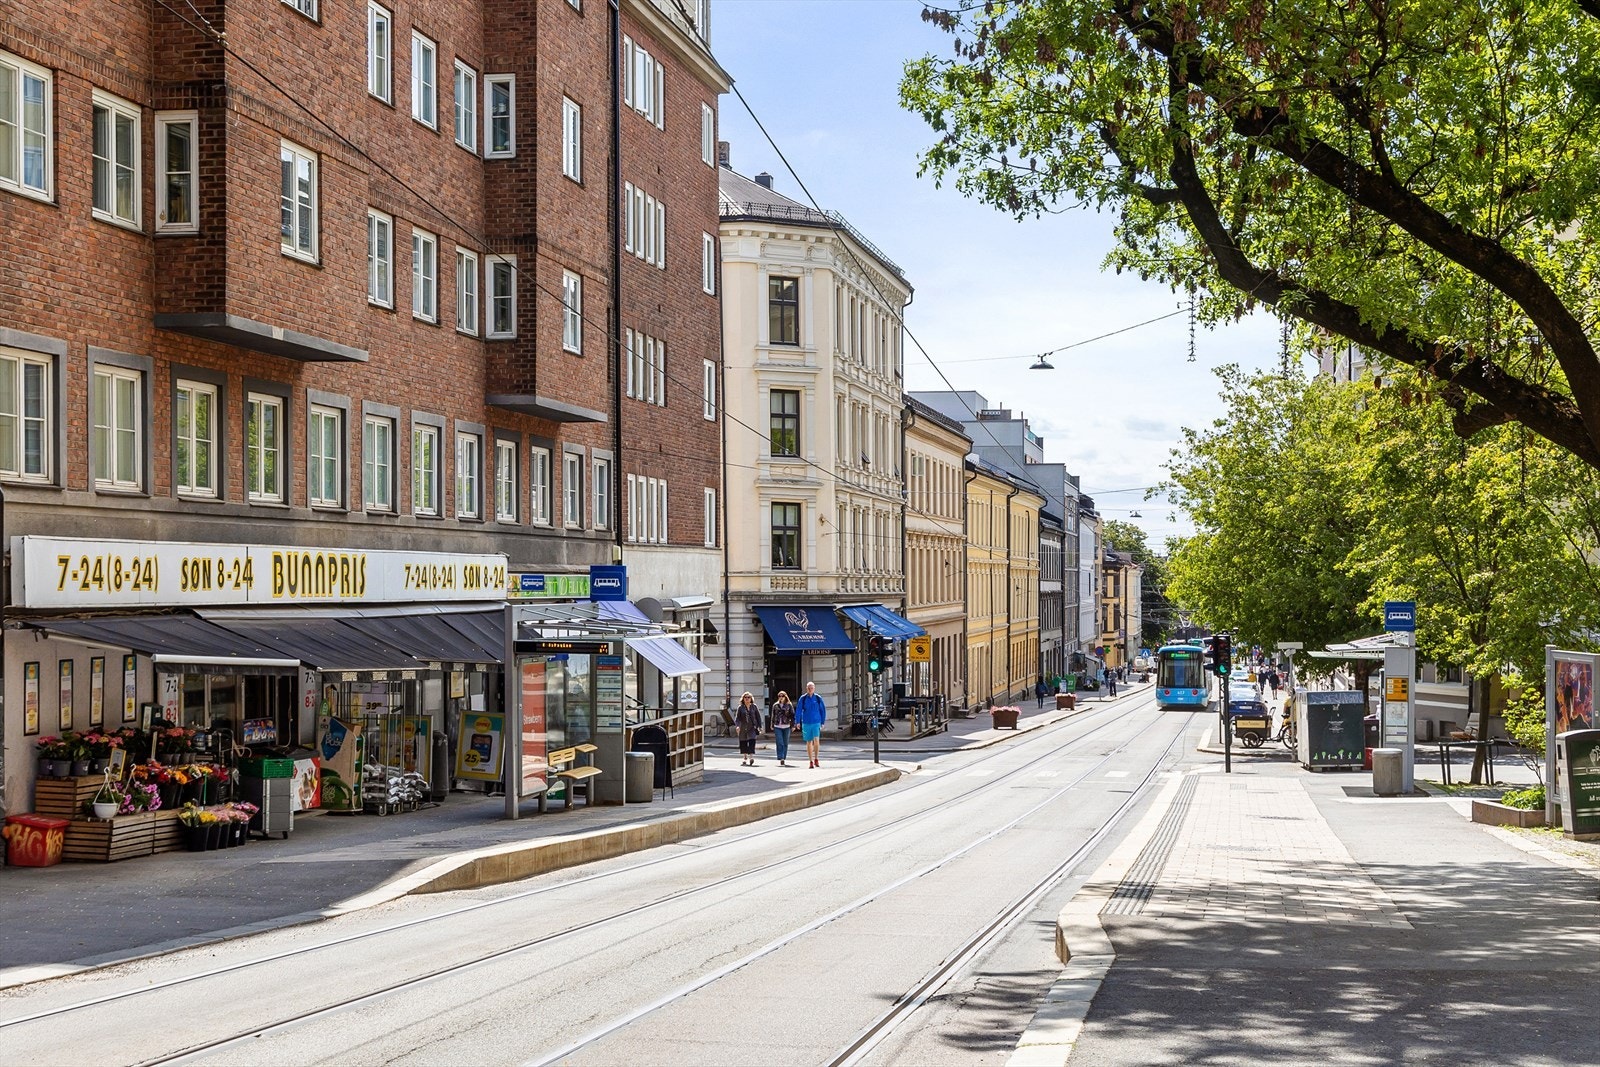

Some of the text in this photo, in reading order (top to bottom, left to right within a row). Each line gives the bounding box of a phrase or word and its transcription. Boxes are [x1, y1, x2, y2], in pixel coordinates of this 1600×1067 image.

[57, 553, 254, 593] 7-24(8-24) SØN 8-24
[272, 551, 367, 598] BUNNPRIS
[404, 562, 505, 591] 7-24(8-24) SØN 8-24
